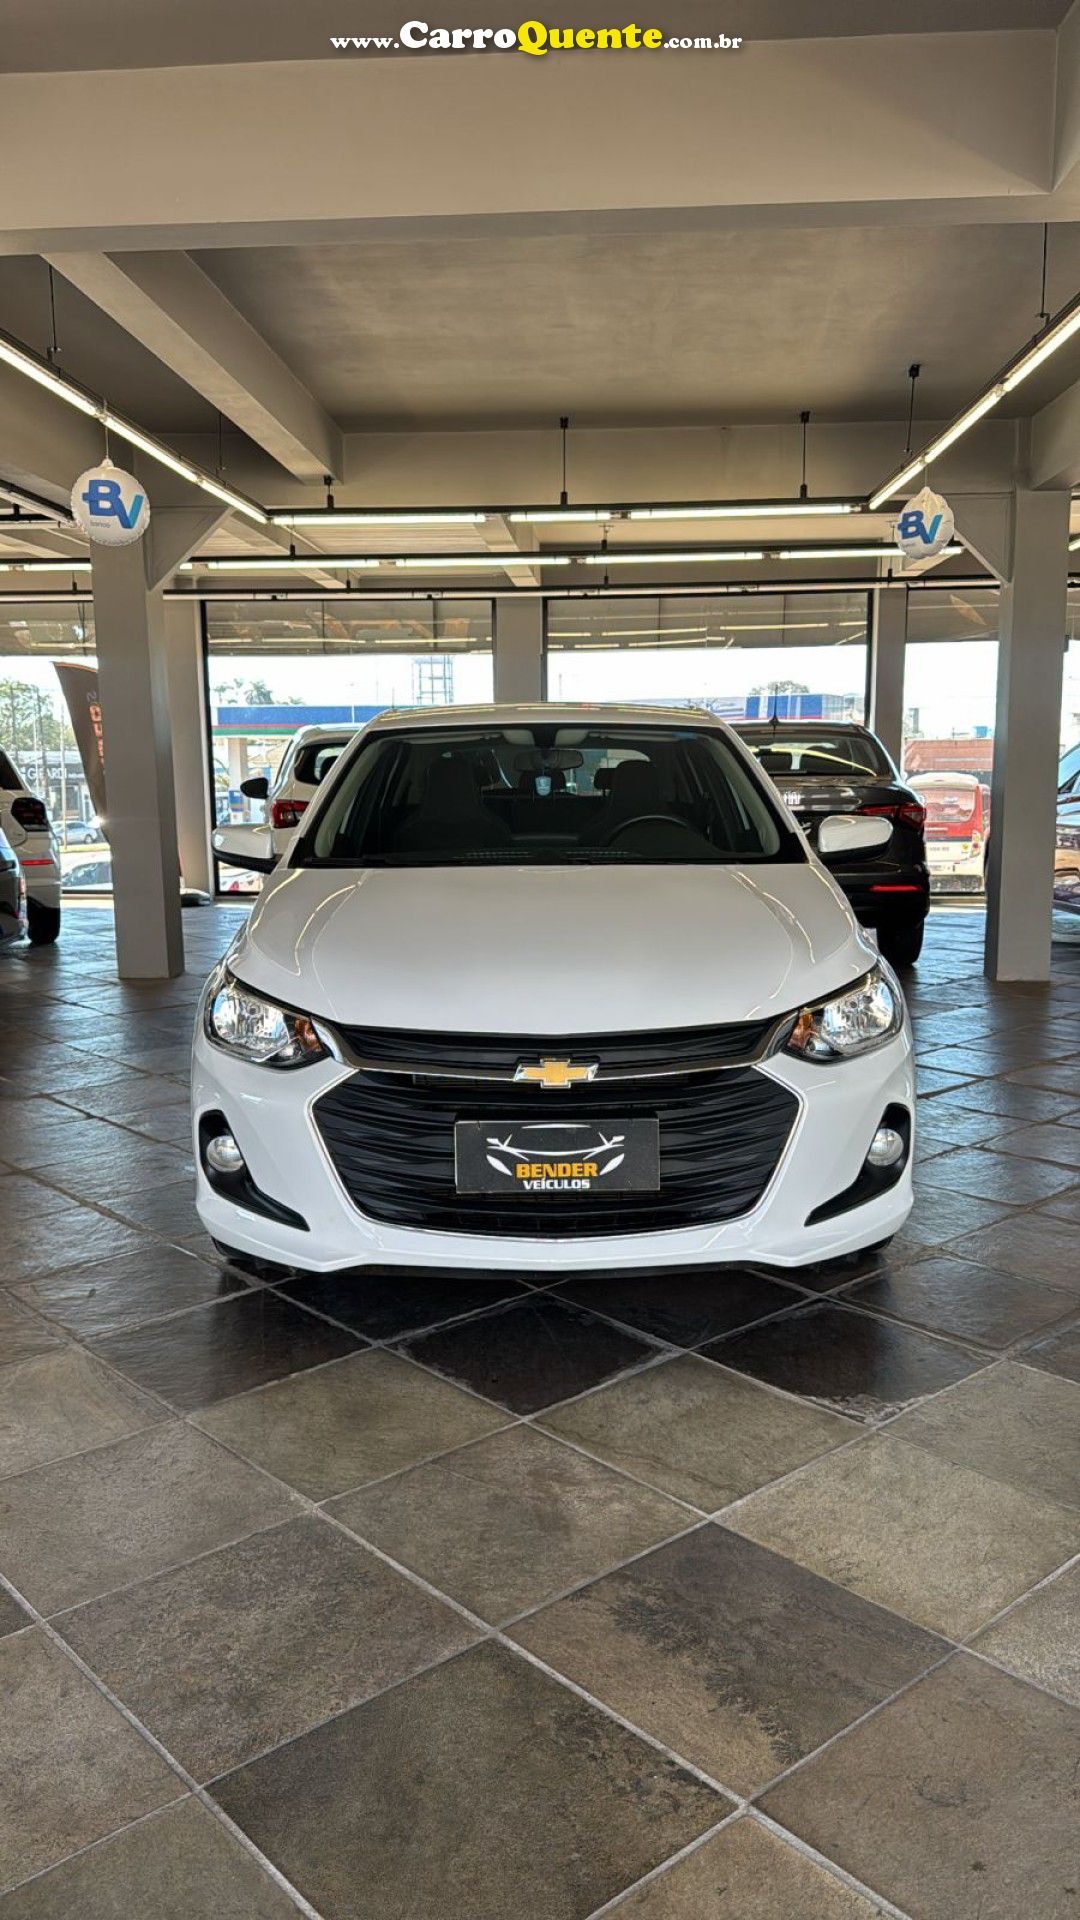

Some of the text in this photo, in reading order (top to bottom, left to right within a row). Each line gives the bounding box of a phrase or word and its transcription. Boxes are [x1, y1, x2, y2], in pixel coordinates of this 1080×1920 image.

[82, 480, 144, 529] BV
[897, 510, 943, 544] BV
[516, 1163, 598, 1178] BENDER
[523, 1177, 590, 1189] VEÍCULOS
